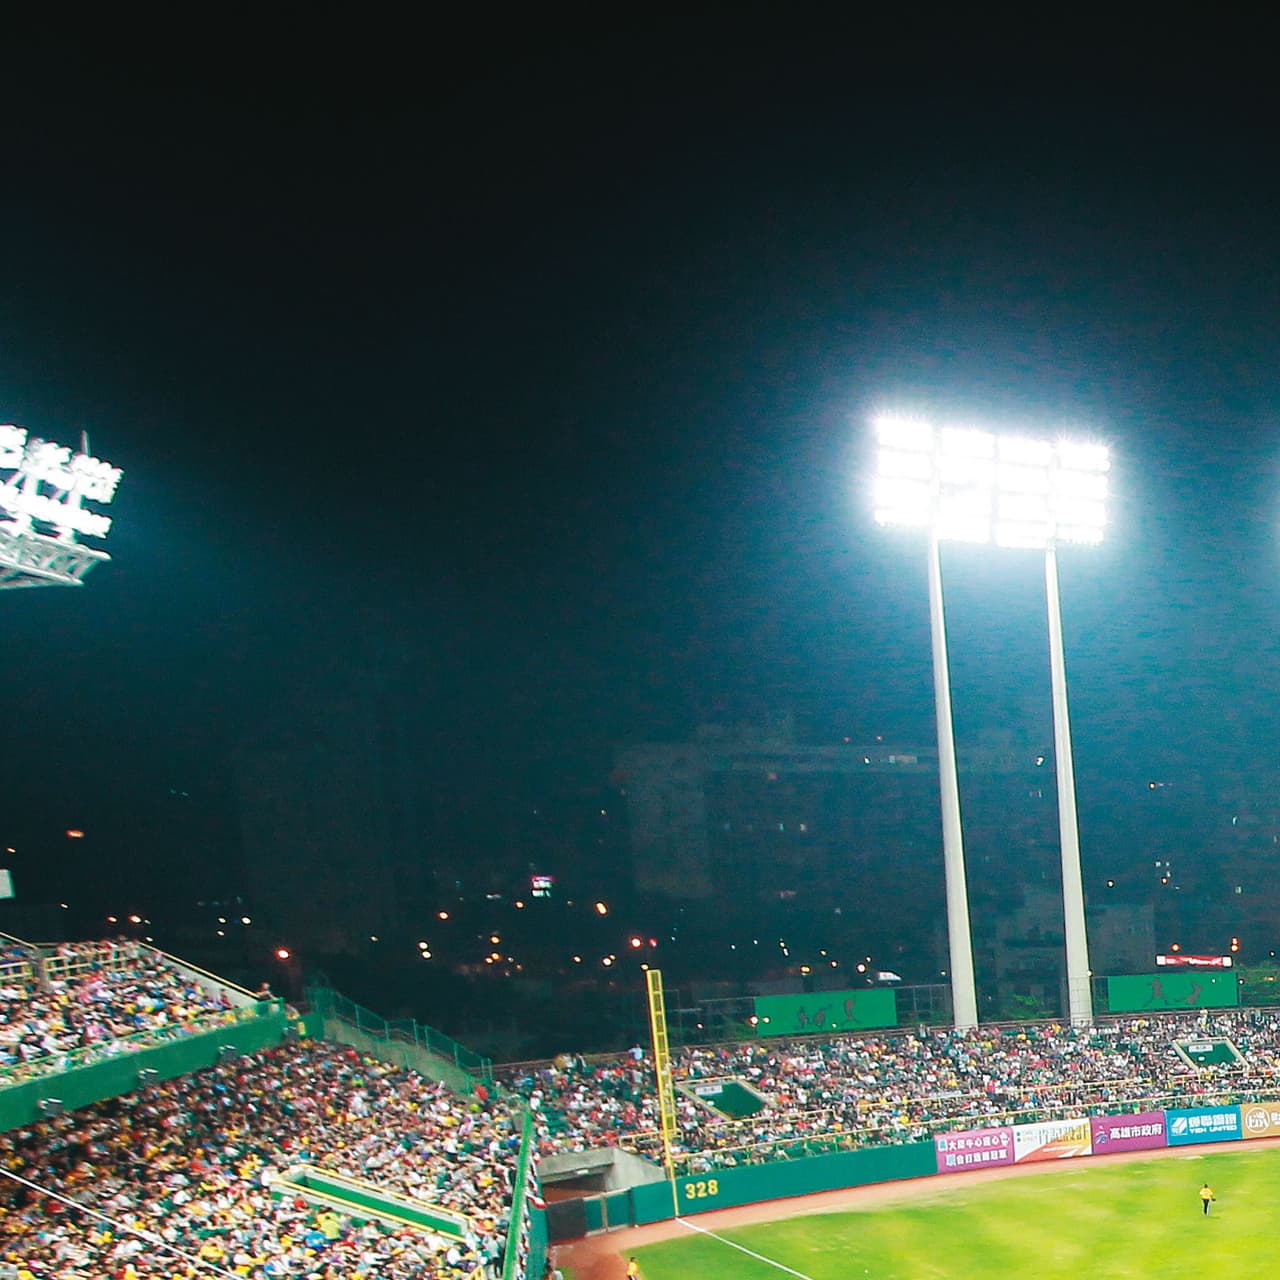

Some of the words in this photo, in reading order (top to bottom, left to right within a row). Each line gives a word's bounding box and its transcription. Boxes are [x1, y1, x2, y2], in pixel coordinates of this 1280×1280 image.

[1109, 1123, 1162, 1140] 高雄市政府
[684, 1179, 719, 1200] 328
